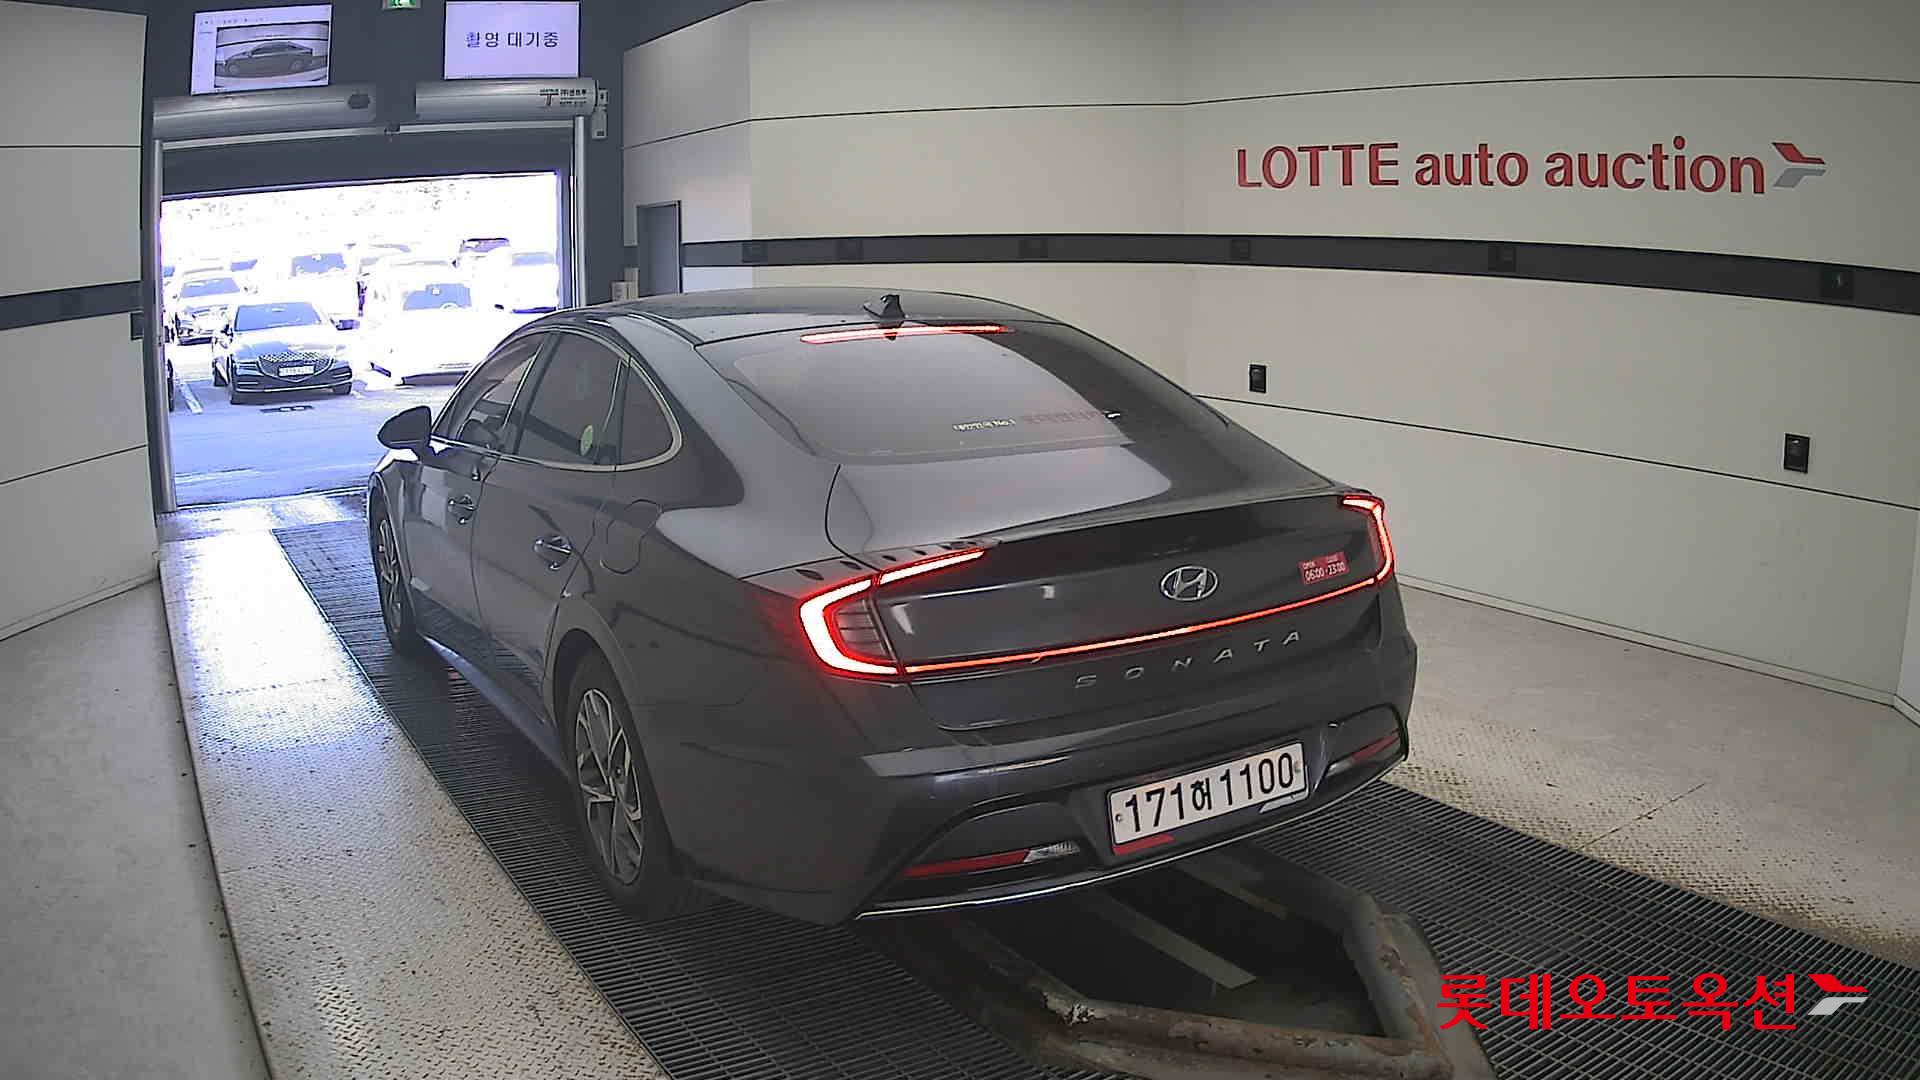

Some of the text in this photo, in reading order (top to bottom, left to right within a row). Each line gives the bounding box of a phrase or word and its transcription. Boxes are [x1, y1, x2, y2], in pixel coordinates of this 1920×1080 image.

[507, 31, 559, 48] 대기중
[1238, 136, 1764, 194] LOTTE auto auction
[1075, 631, 1300, 689] SONATA
